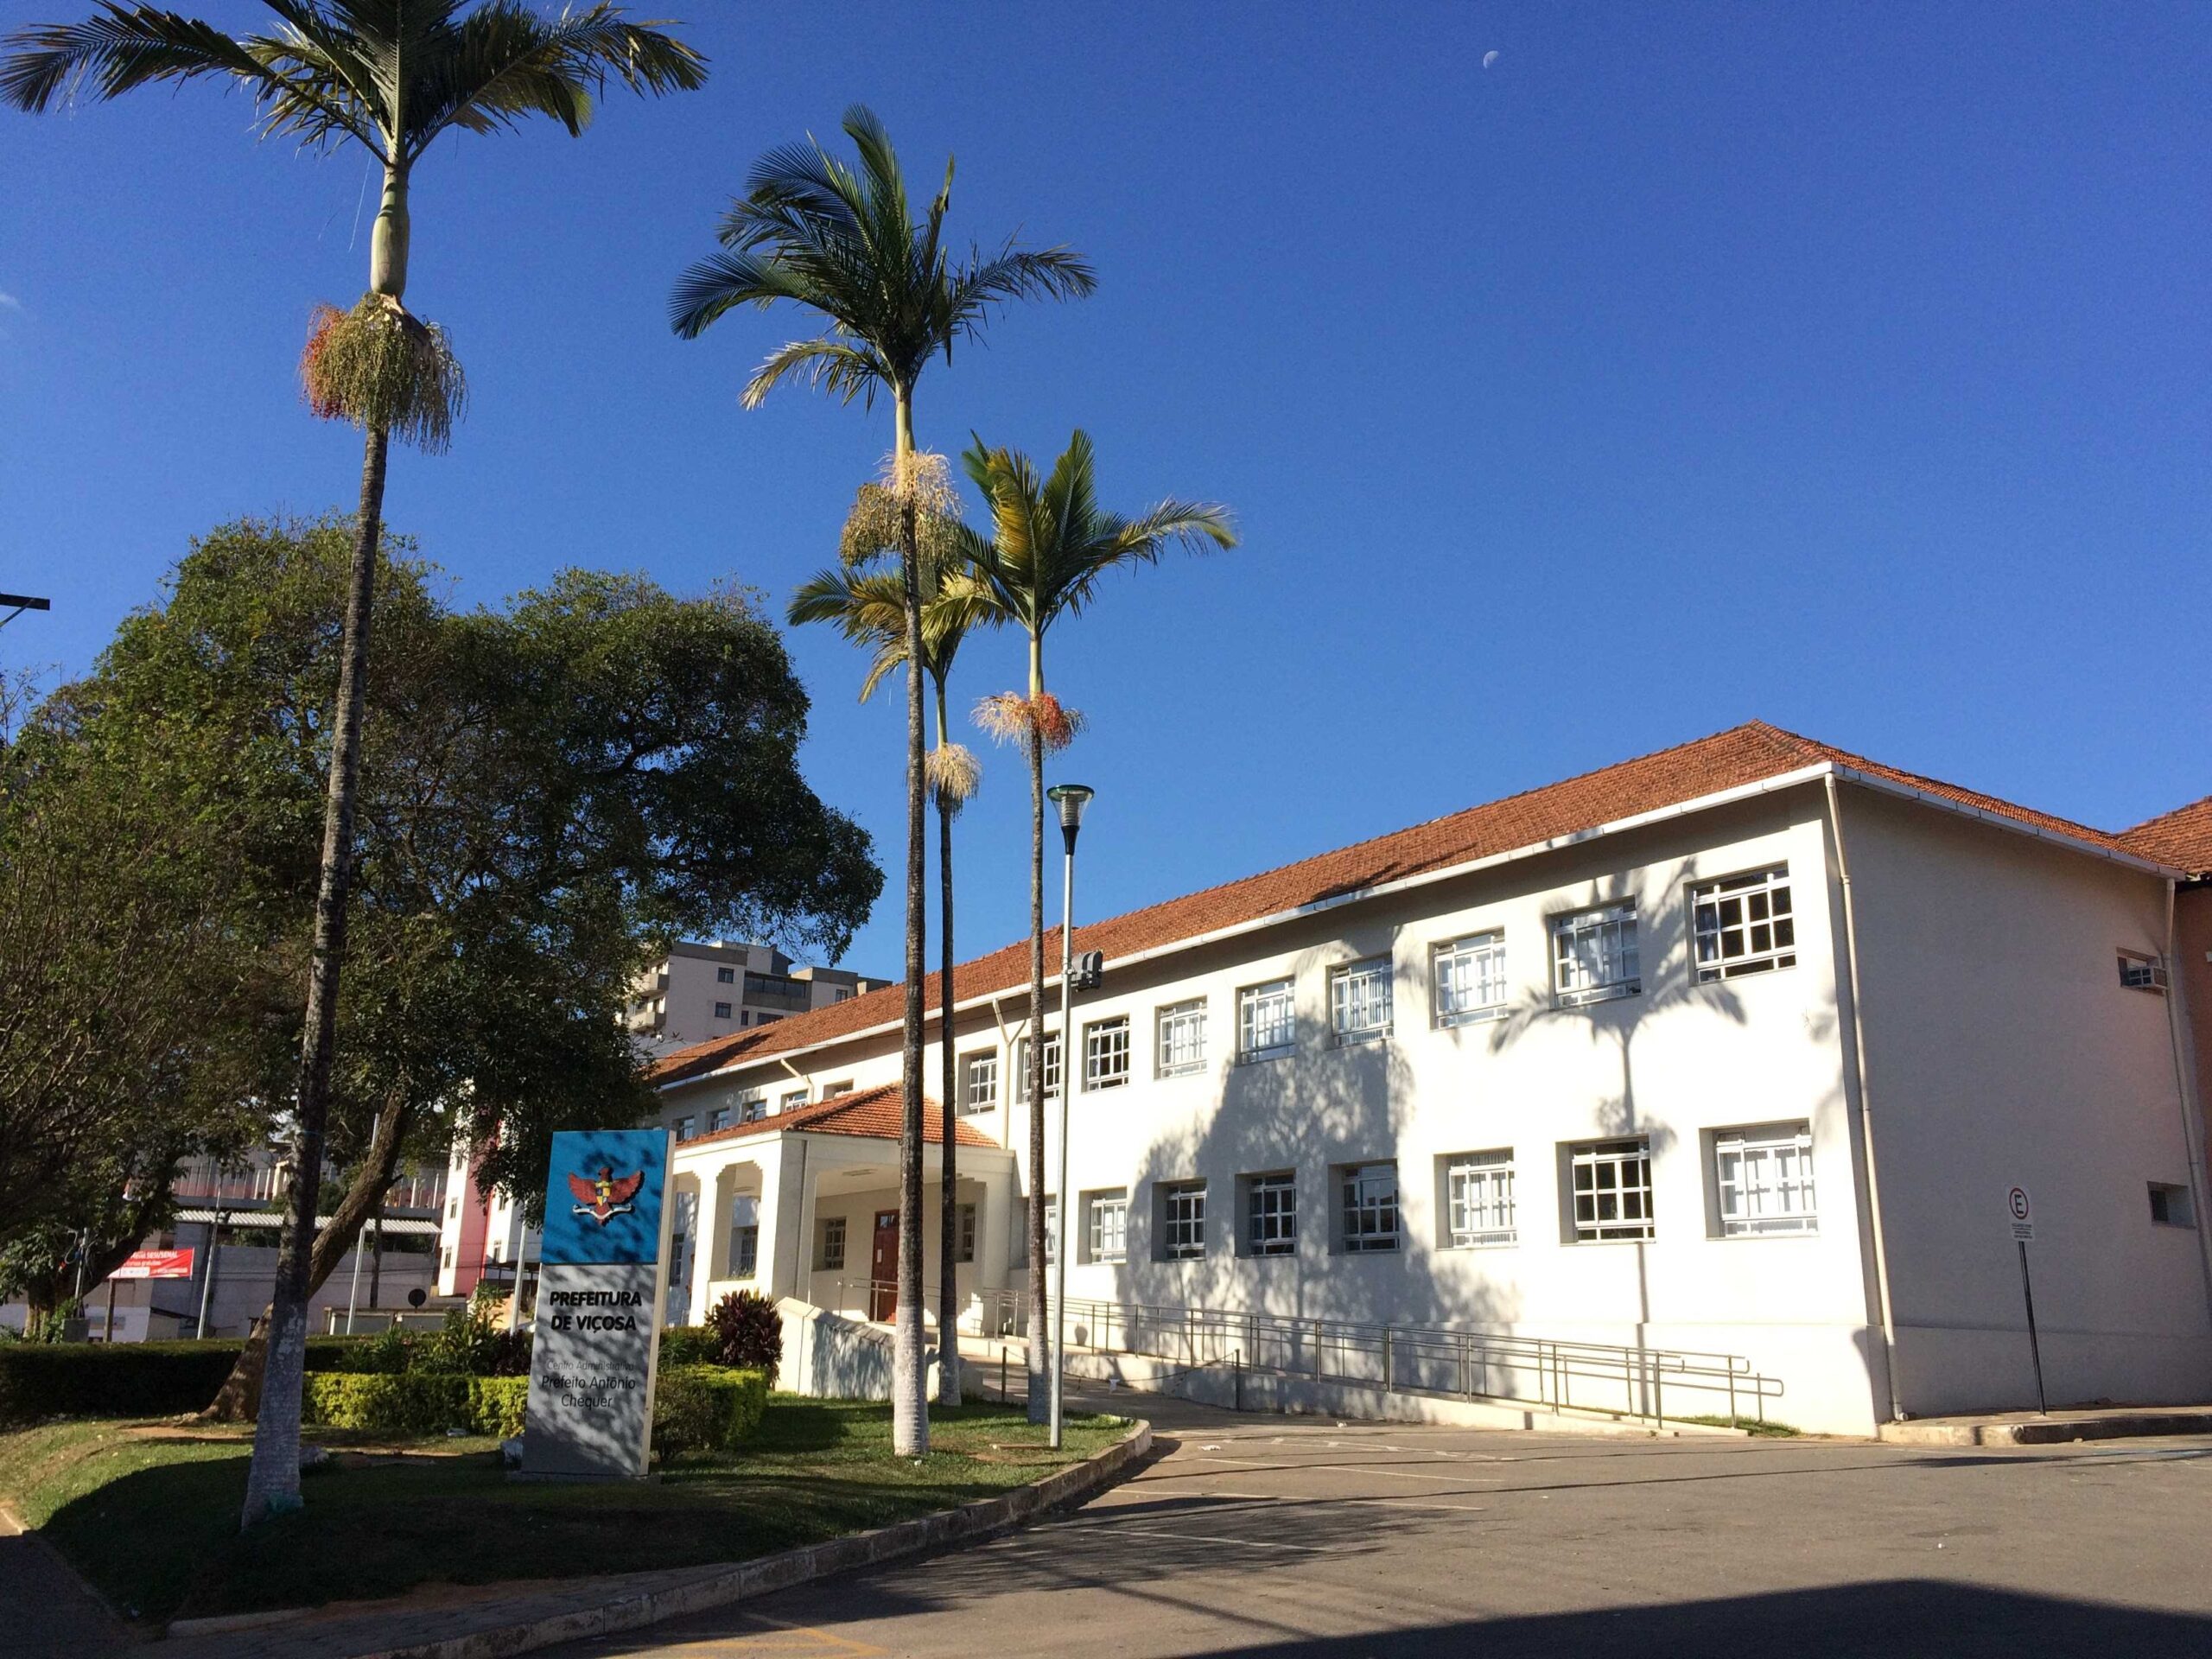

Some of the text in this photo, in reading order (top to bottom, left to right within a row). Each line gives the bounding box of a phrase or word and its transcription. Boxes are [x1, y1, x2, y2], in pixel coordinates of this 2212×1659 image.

[2014, 1194, 2024, 1214] E
[550, 1291, 642, 1306] PREFEITURA
[551, 1315, 637, 1333] DE VIÇOSA
[547, 1359, 634, 1370] Centro Administrativo
[542, 1375, 636, 1389] Prefeito Antônio
[561, 1394, 613, 1410] Chequer
